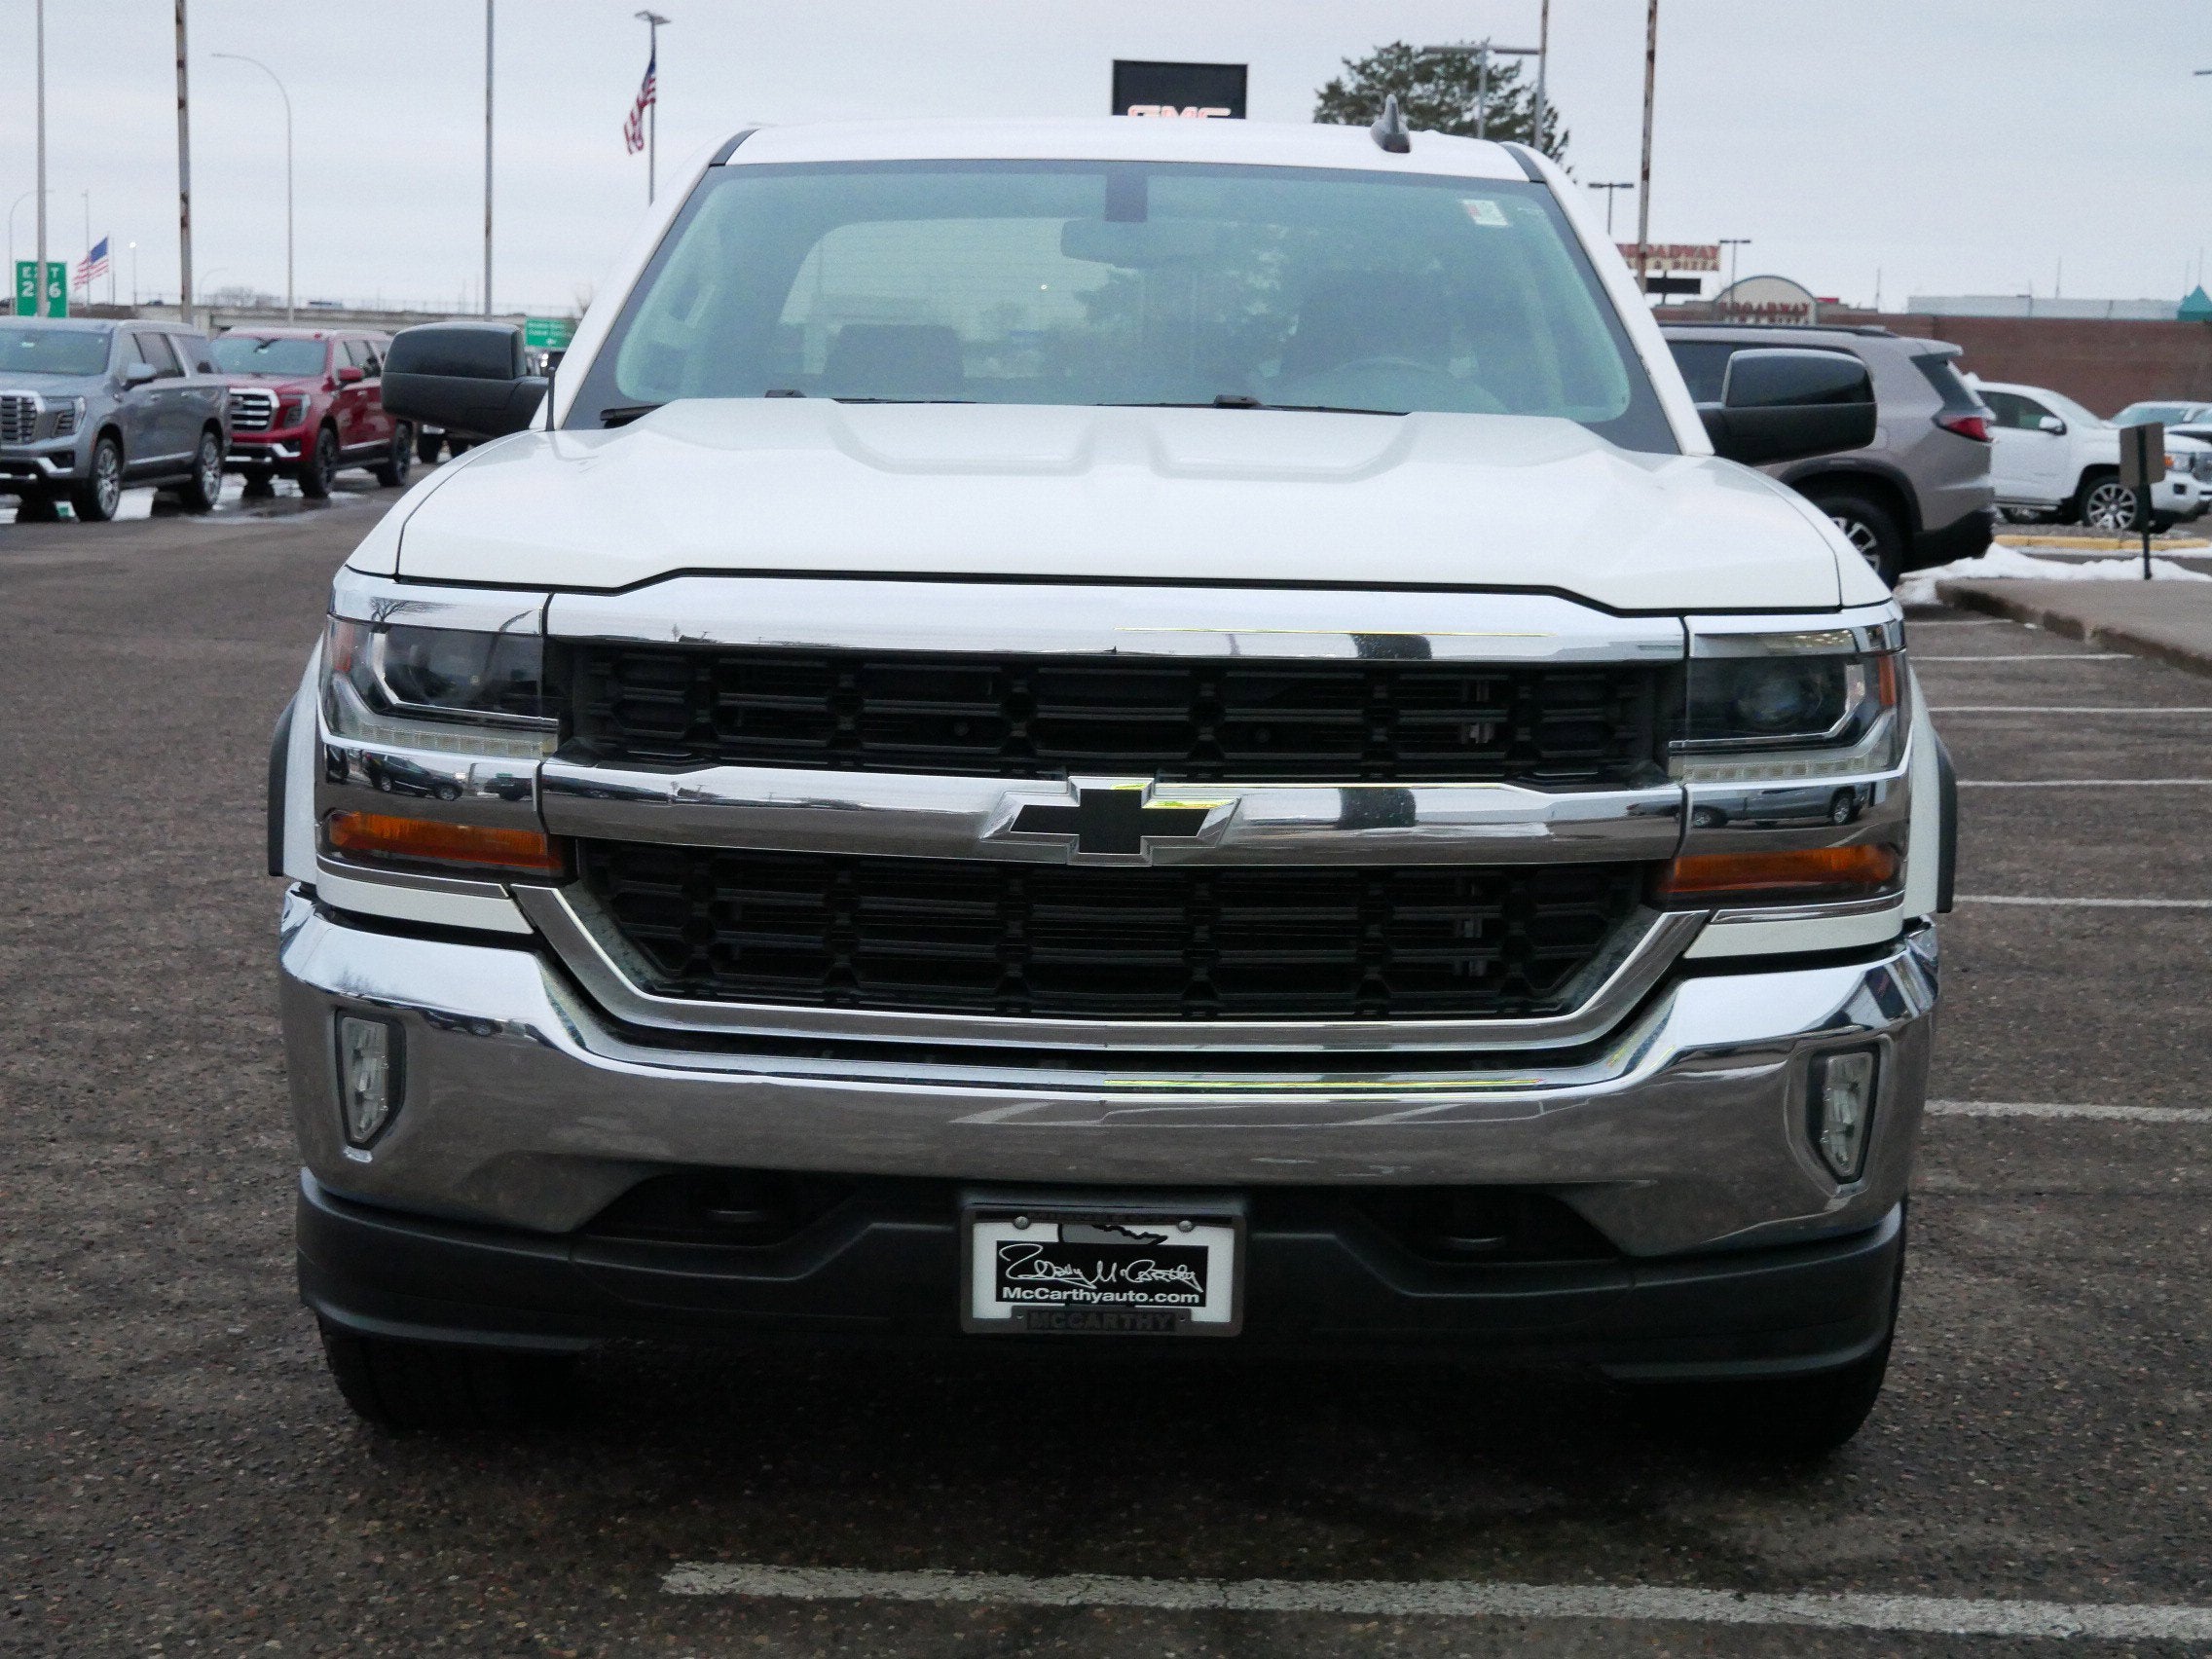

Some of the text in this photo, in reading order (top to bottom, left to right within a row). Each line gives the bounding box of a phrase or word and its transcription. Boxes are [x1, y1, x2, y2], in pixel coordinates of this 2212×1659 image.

[21, 266, 59, 278] ET
[21, 280, 62, 298] 26
[1002, 1286, 1200, 1305] McCarthyauto.com
